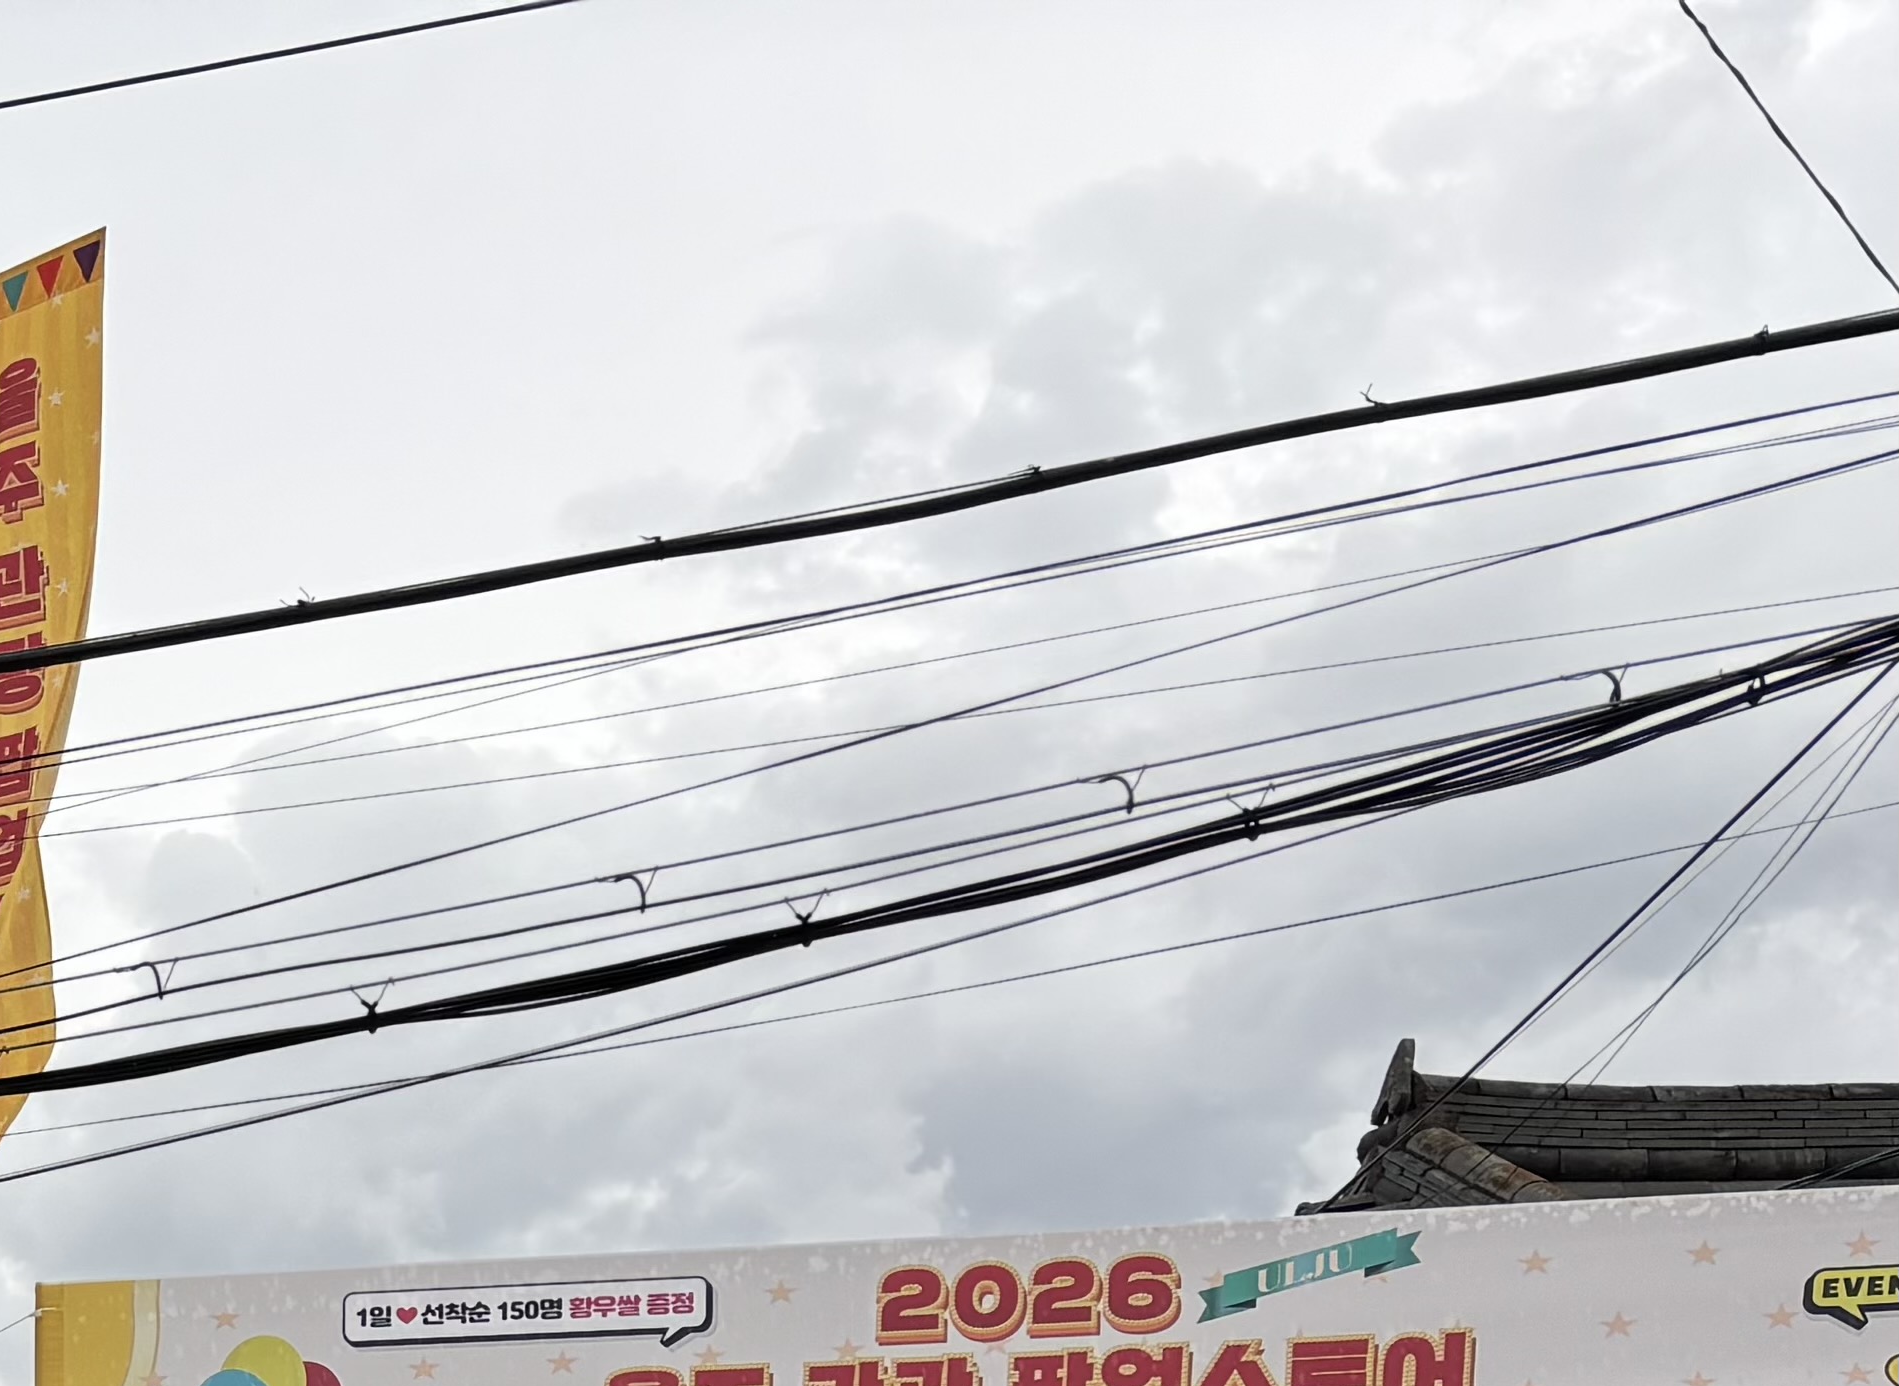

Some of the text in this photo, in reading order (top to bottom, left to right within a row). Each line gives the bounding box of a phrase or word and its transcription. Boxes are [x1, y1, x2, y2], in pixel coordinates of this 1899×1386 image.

[1255, 1243, 1356, 1297] ULJU
[1822, 1275, 1899, 1298] EVEN
[356, 1292, 695, 1328] 1일 선착순 150명 황우쌀 증정
[876, 1251, 1182, 1346] 2026
